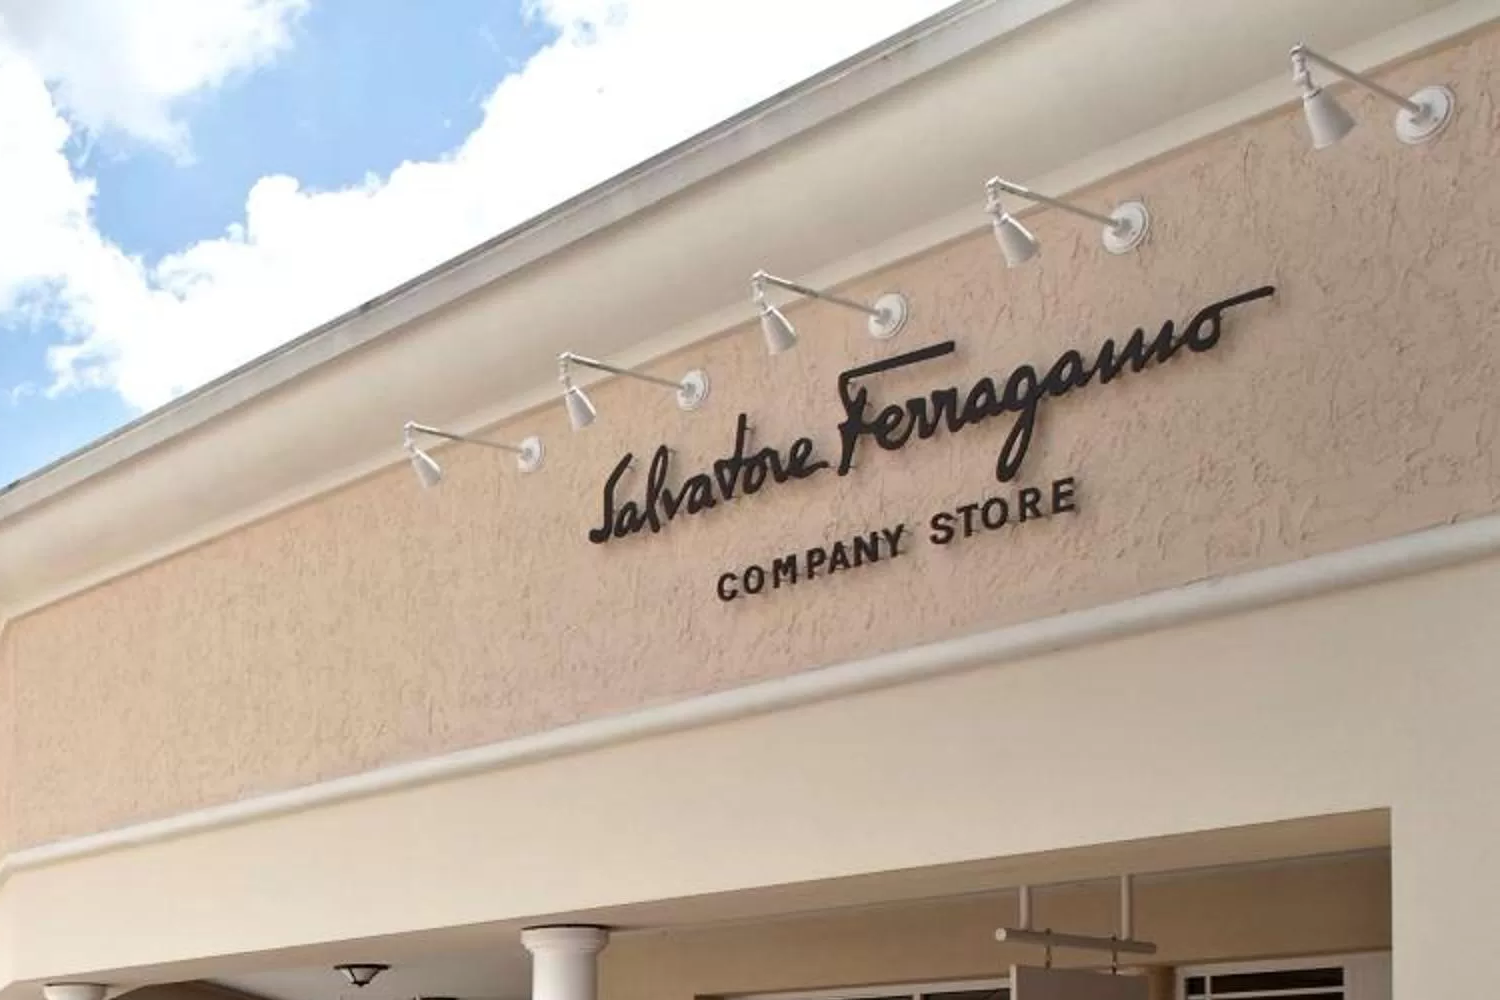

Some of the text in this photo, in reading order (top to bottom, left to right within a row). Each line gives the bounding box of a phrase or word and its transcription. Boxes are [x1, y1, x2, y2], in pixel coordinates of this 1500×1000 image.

[589, 285, 1275, 543] Salvatore Ferragamo
[716, 476, 1078, 603] COMPANY STORE
